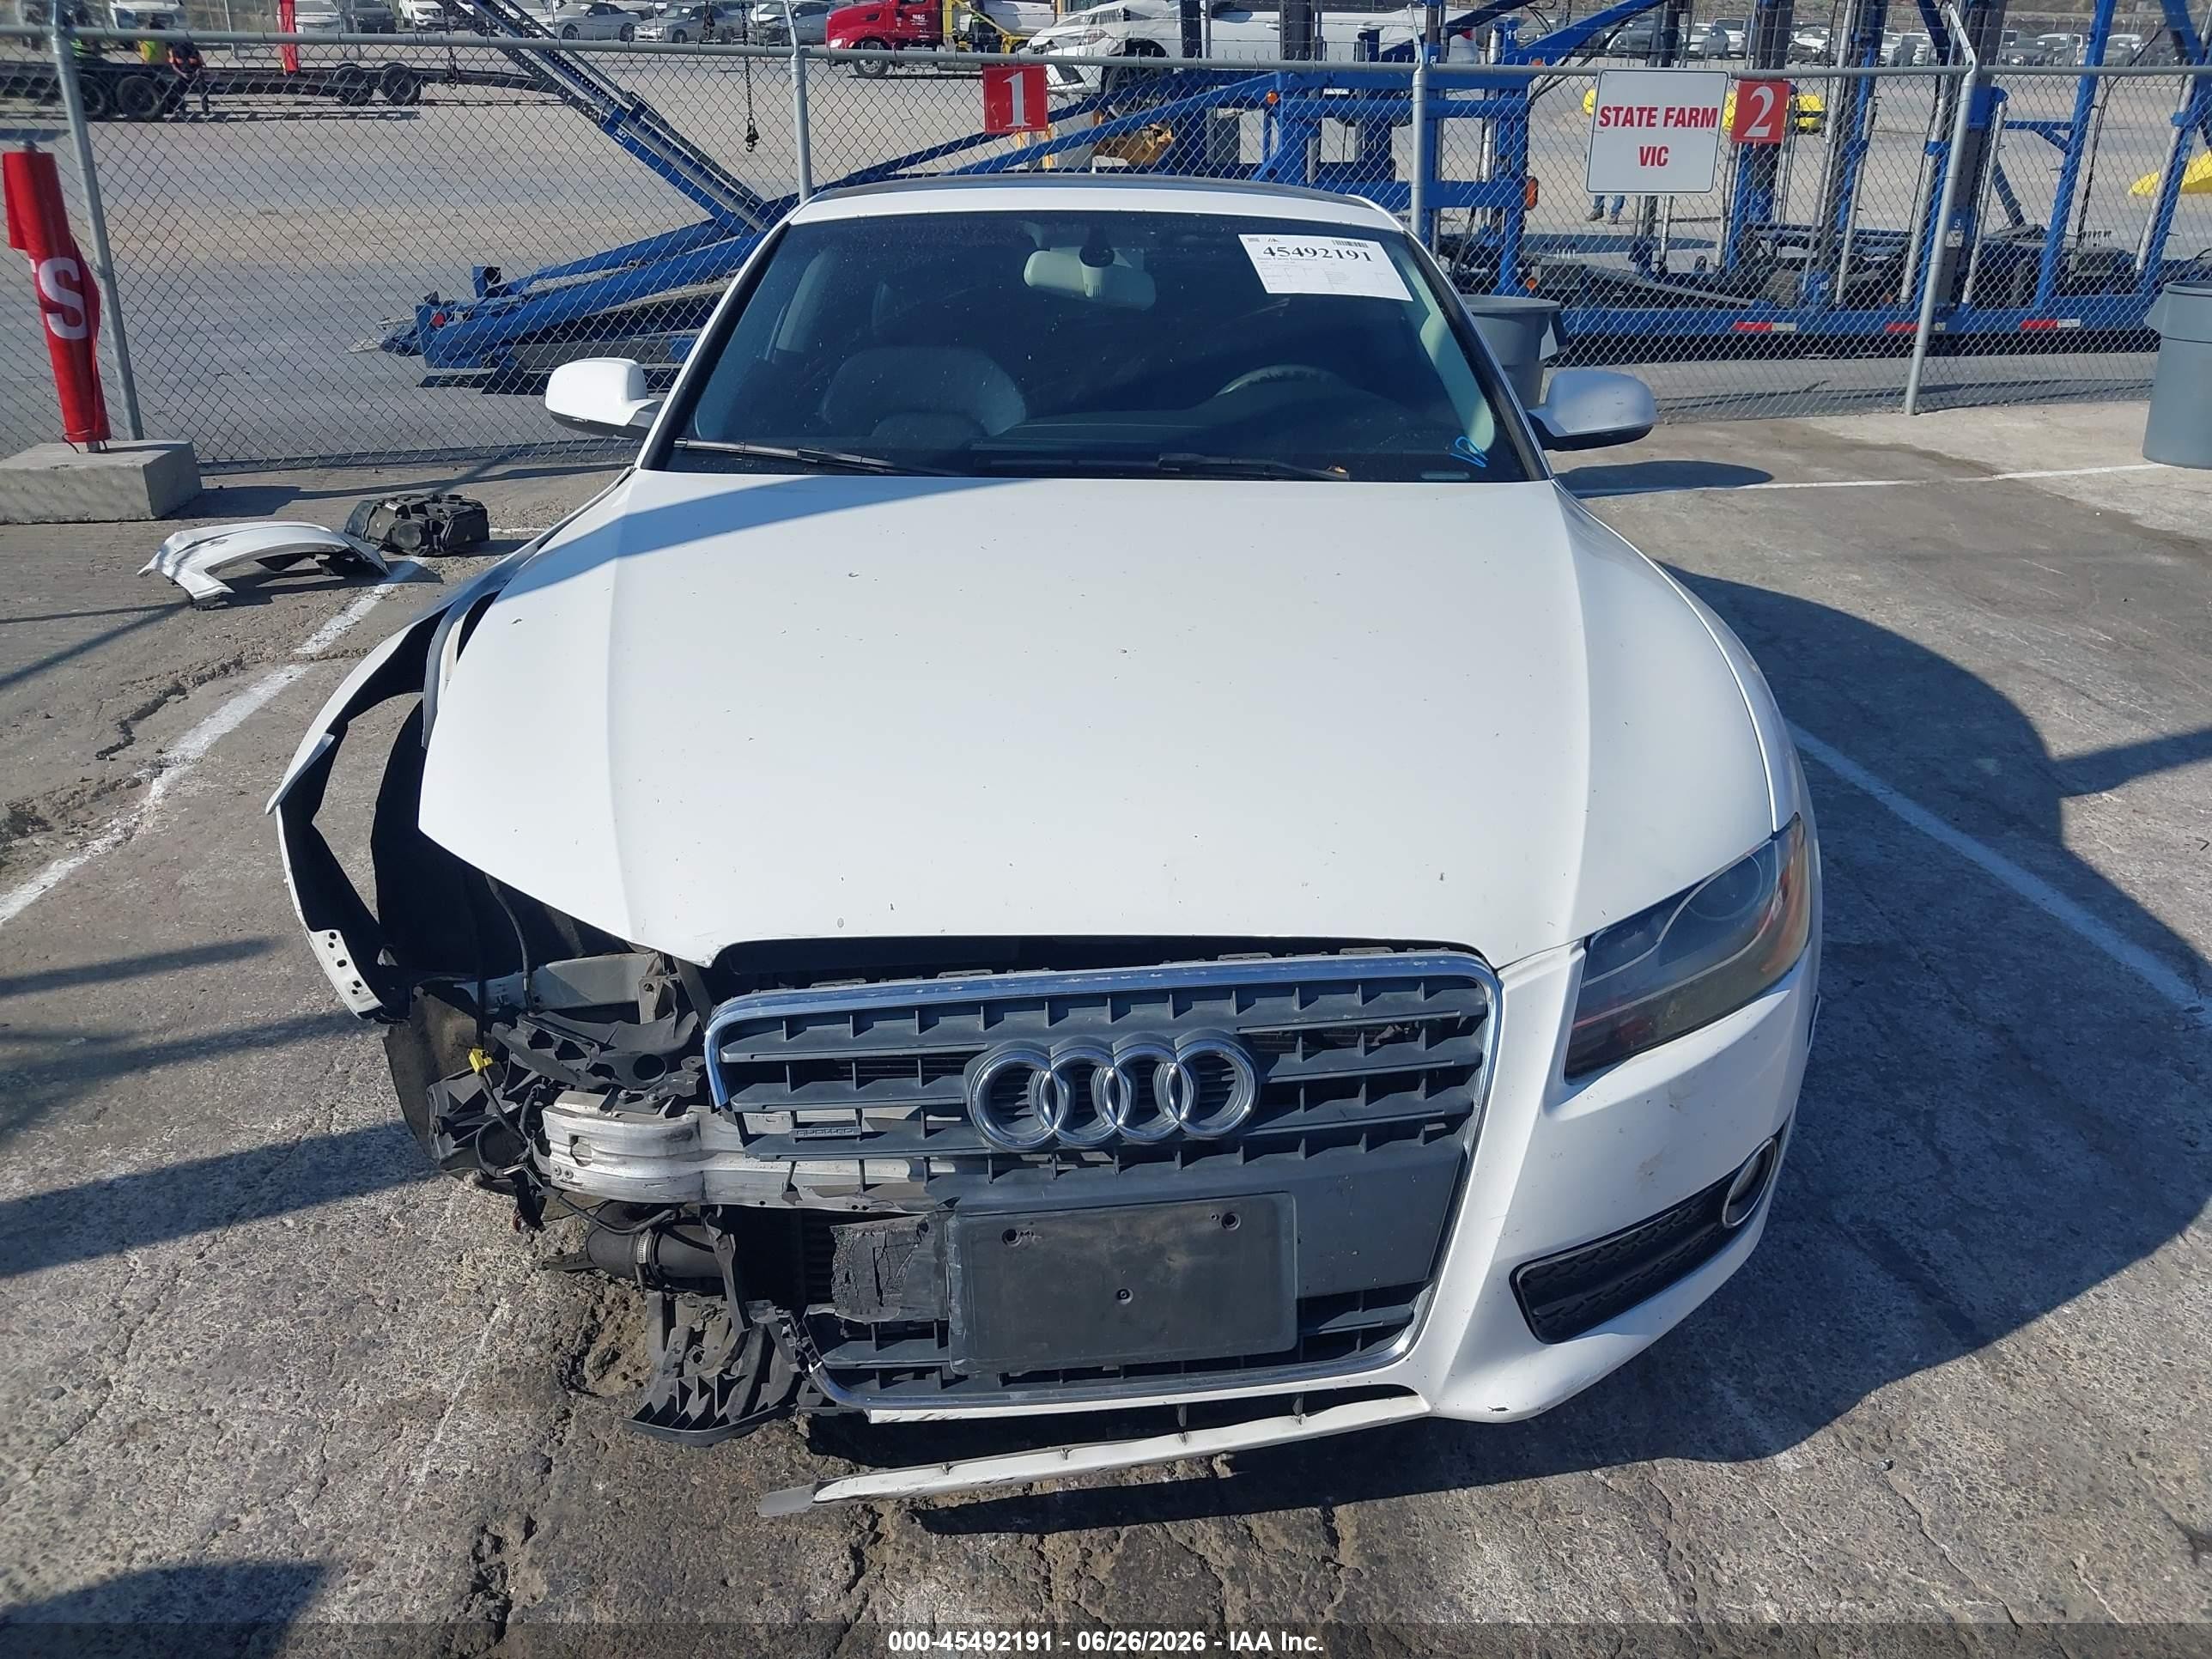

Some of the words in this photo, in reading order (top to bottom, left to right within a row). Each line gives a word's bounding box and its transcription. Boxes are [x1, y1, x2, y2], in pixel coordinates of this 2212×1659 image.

[1506, 29, 1518, 40] 11
[1003, 71, 1032, 127] 1
[1598, 106, 1658, 127] STATE
[1662, 106, 1718, 128] FARM
[1744, 86, 1774, 137] 2
[1638, 146, 1669, 167] VIC
[1263, 246, 1374, 263] 45492191
[29, 257, 88, 339] S
